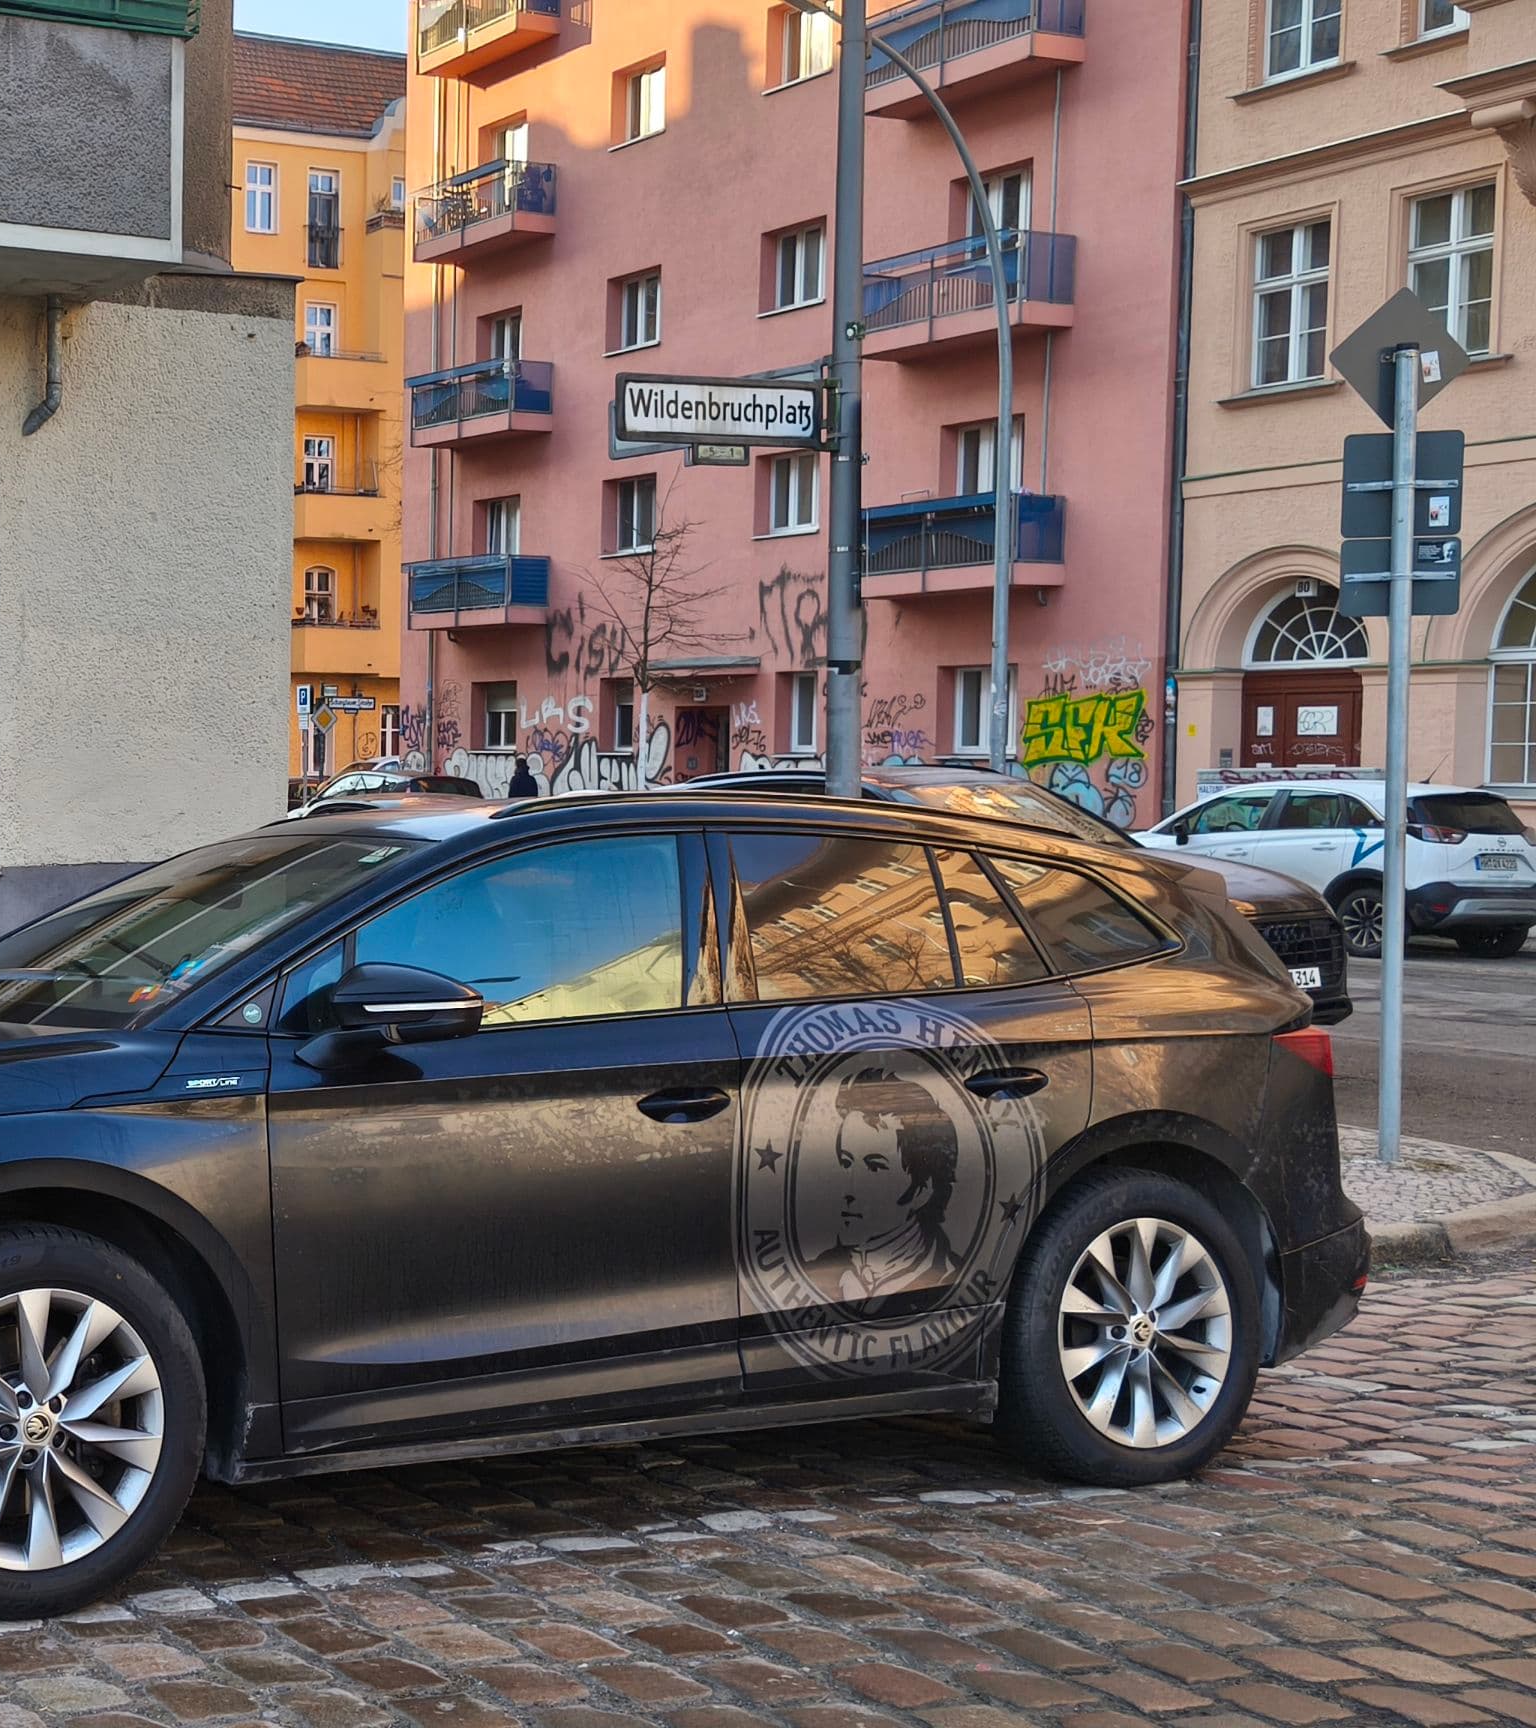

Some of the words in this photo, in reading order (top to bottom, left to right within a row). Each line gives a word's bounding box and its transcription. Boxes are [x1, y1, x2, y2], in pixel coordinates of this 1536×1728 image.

[629, 387, 811, 431] Wildenbruchplatz
[774, 1004, 902, 1088] THOMAS
[753, 1229, 878, 1367] AUTHENTIC
[889, 1269, 997, 1368] FLAVOUR
